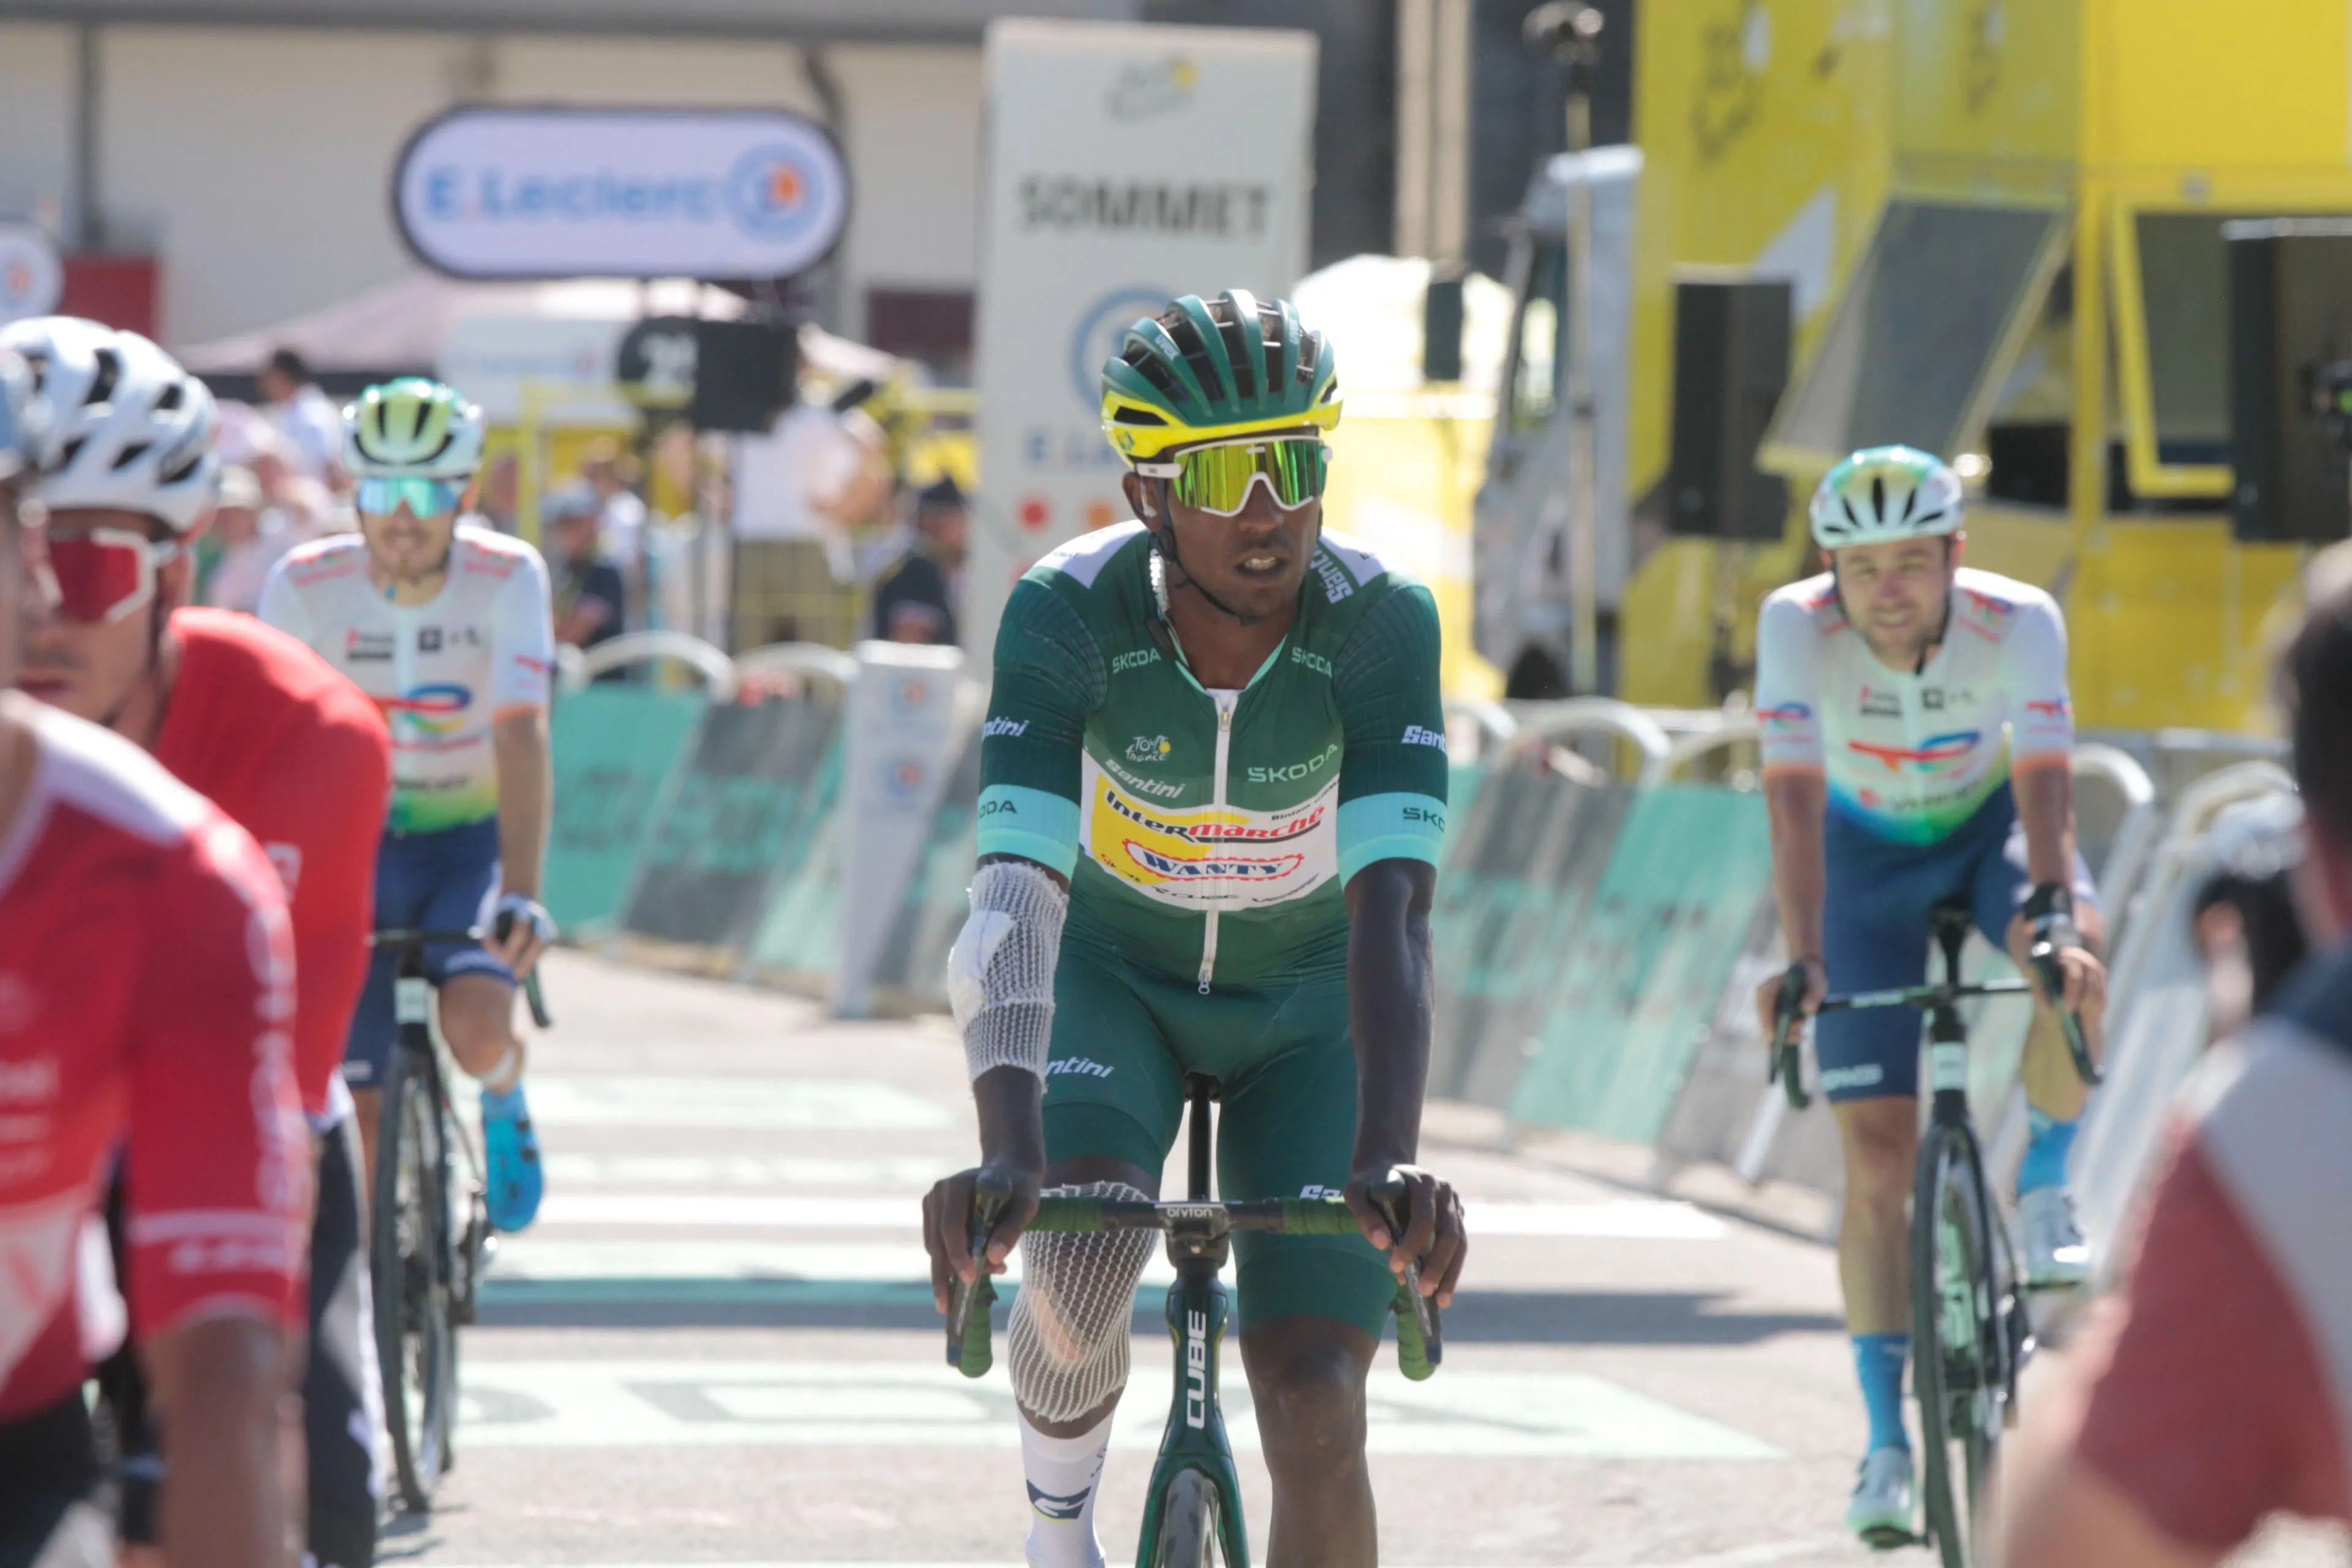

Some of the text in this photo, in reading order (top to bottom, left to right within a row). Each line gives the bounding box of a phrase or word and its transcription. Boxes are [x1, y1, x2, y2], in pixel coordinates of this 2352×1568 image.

[1018, 173, 1273, 238] SOMMET
[1104, 758, 1186, 799] Santini
[1142, 850, 1284, 875] WANTY
[1186, 1308, 1207, 1430] CUBE
